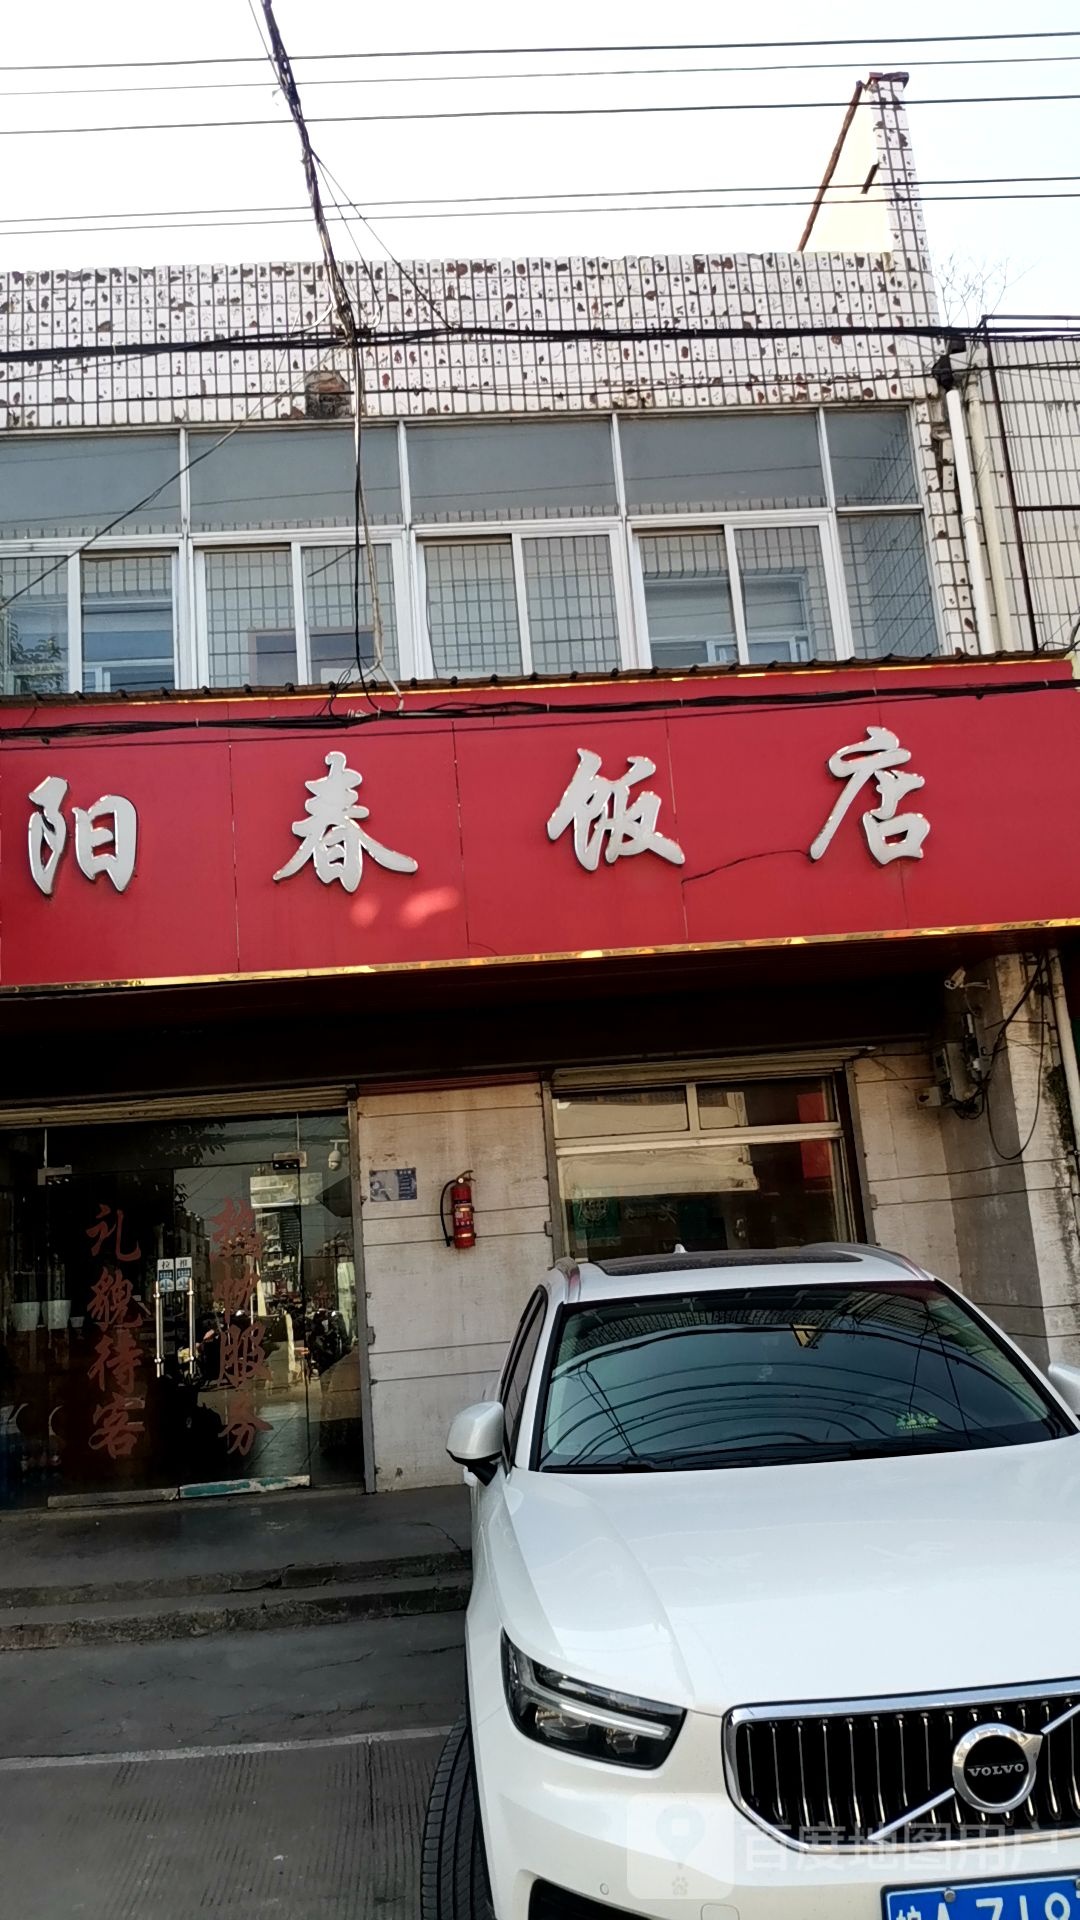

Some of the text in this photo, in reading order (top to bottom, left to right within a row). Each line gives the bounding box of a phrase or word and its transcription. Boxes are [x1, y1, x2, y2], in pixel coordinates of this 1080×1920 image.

[27, 727, 931, 894] 阳春饭店
[85, 1202, 146, 1459] 礼貌待客
[967, 1763, 1024, 1777] VOLVO
